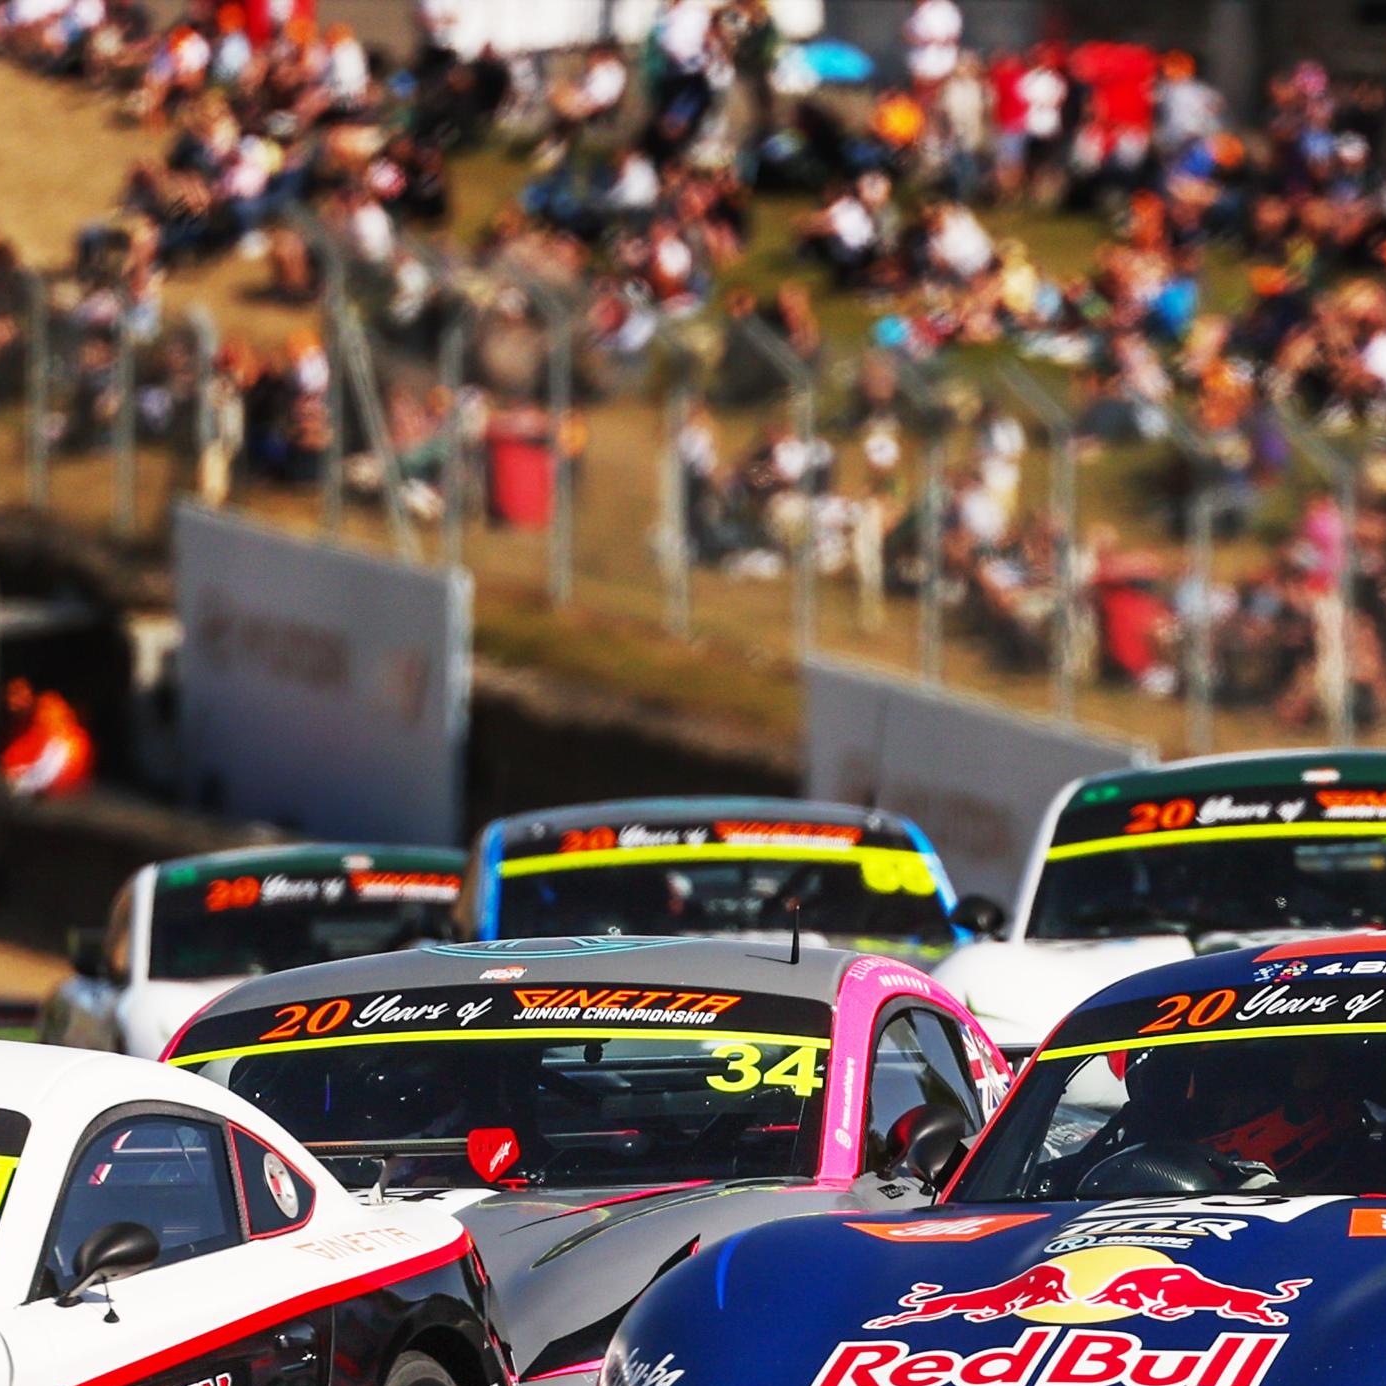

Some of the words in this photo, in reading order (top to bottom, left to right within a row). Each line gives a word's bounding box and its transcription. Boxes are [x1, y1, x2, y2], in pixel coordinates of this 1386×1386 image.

[1124, 800, 1196, 834] 20
[259, 999, 351, 1041] 20
[351, 995, 450, 1028] Years
[456, 996, 494, 1026] of
[513, 988, 743, 1016] GINETTA
[513, 1006, 578, 1020] JUNIOR
[582, 1006, 718, 1025] CHAMPIONSHIP
[1138, 988, 1237, 1034] 20
[1236, 984, 1339, 1021] Years
[1346, 989, 1386, 1020] of
[706, 1042, 824, 1097] 34
[293, 1228, 421, 1260] GINETTA
